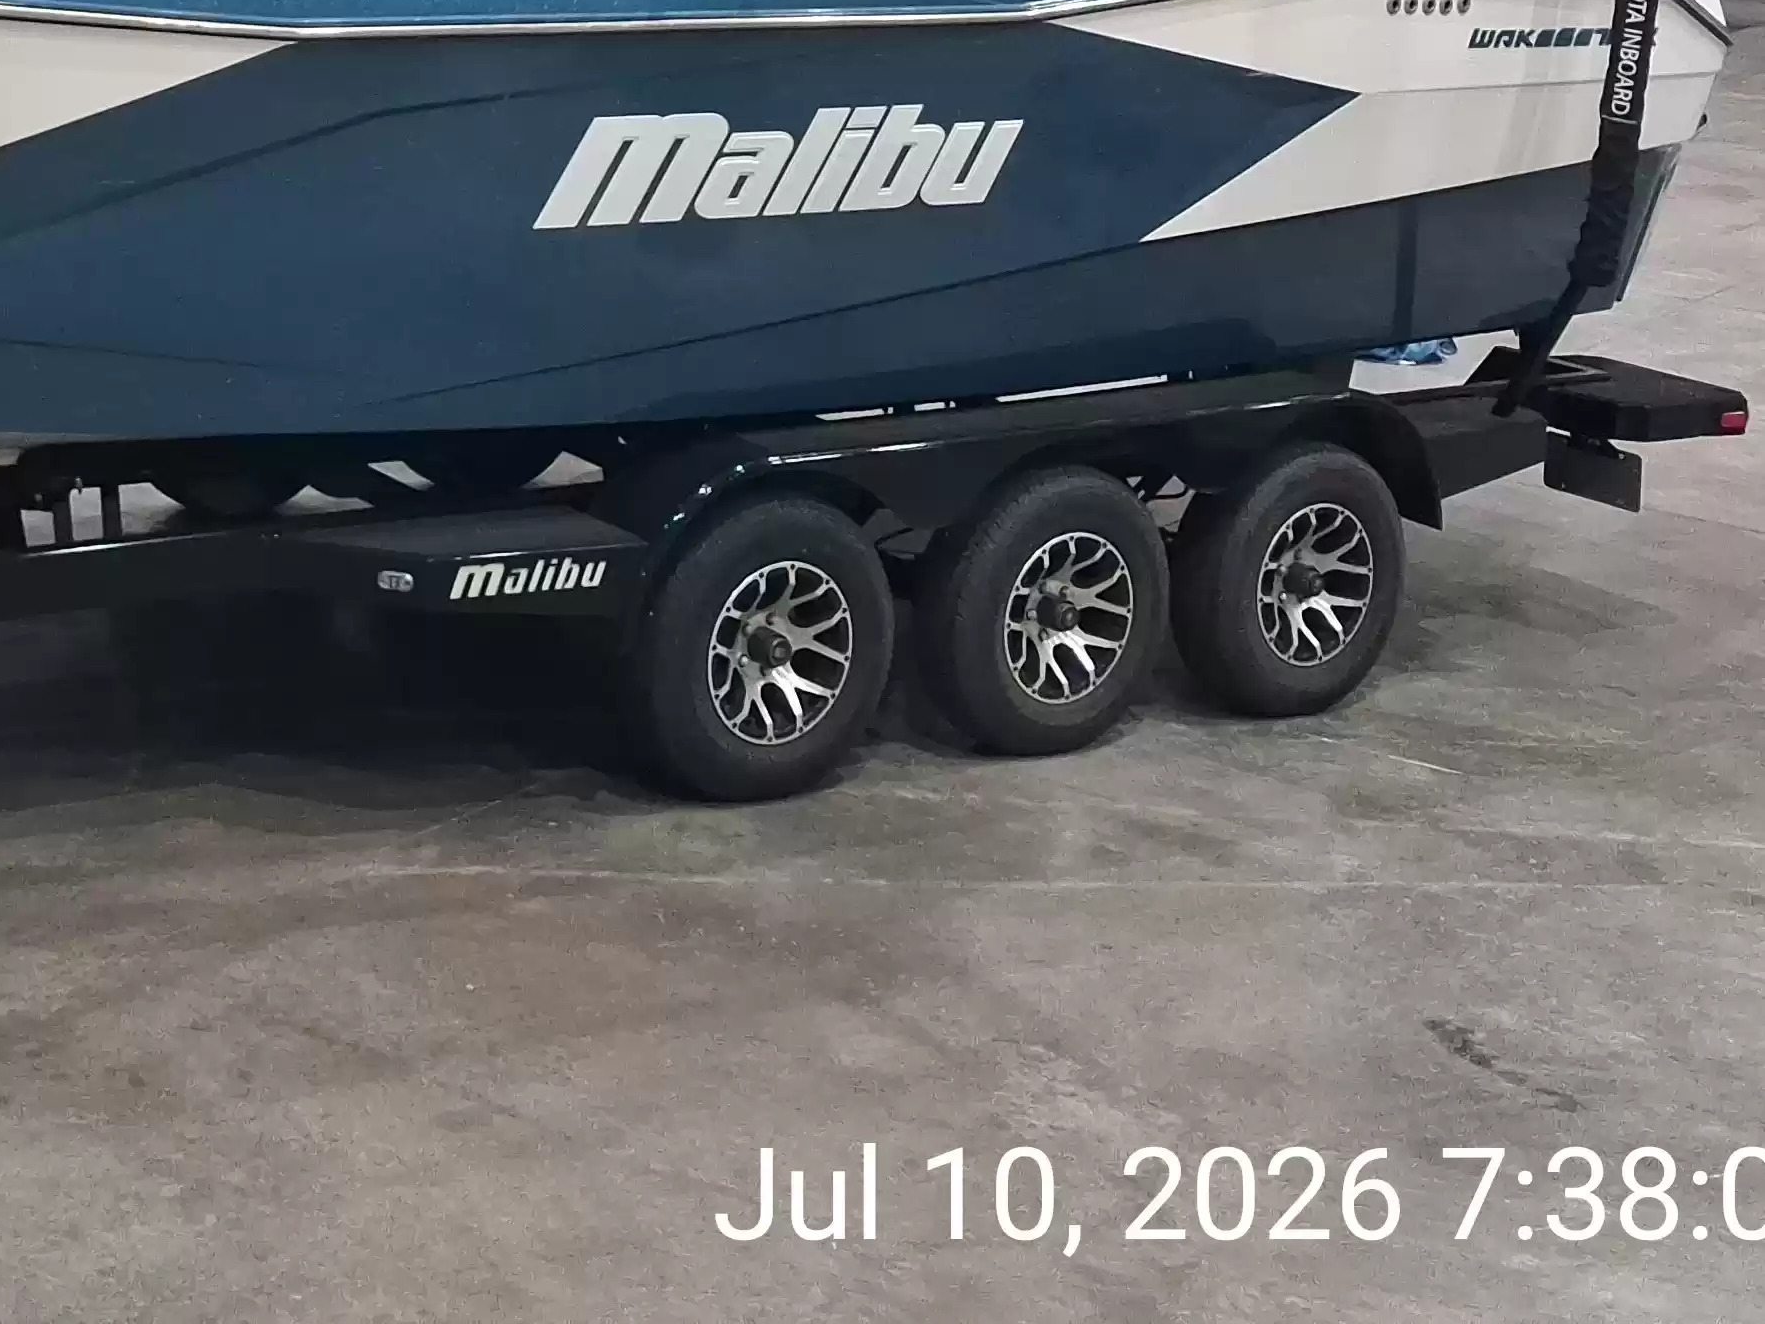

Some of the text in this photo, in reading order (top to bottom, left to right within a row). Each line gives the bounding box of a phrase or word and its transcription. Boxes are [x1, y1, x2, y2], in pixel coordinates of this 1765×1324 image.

[1611, 28, 1643, 116] INBOARD
[533, 104, 1024, 229] Malibu
[449, 557, 607, 600] Malibu
